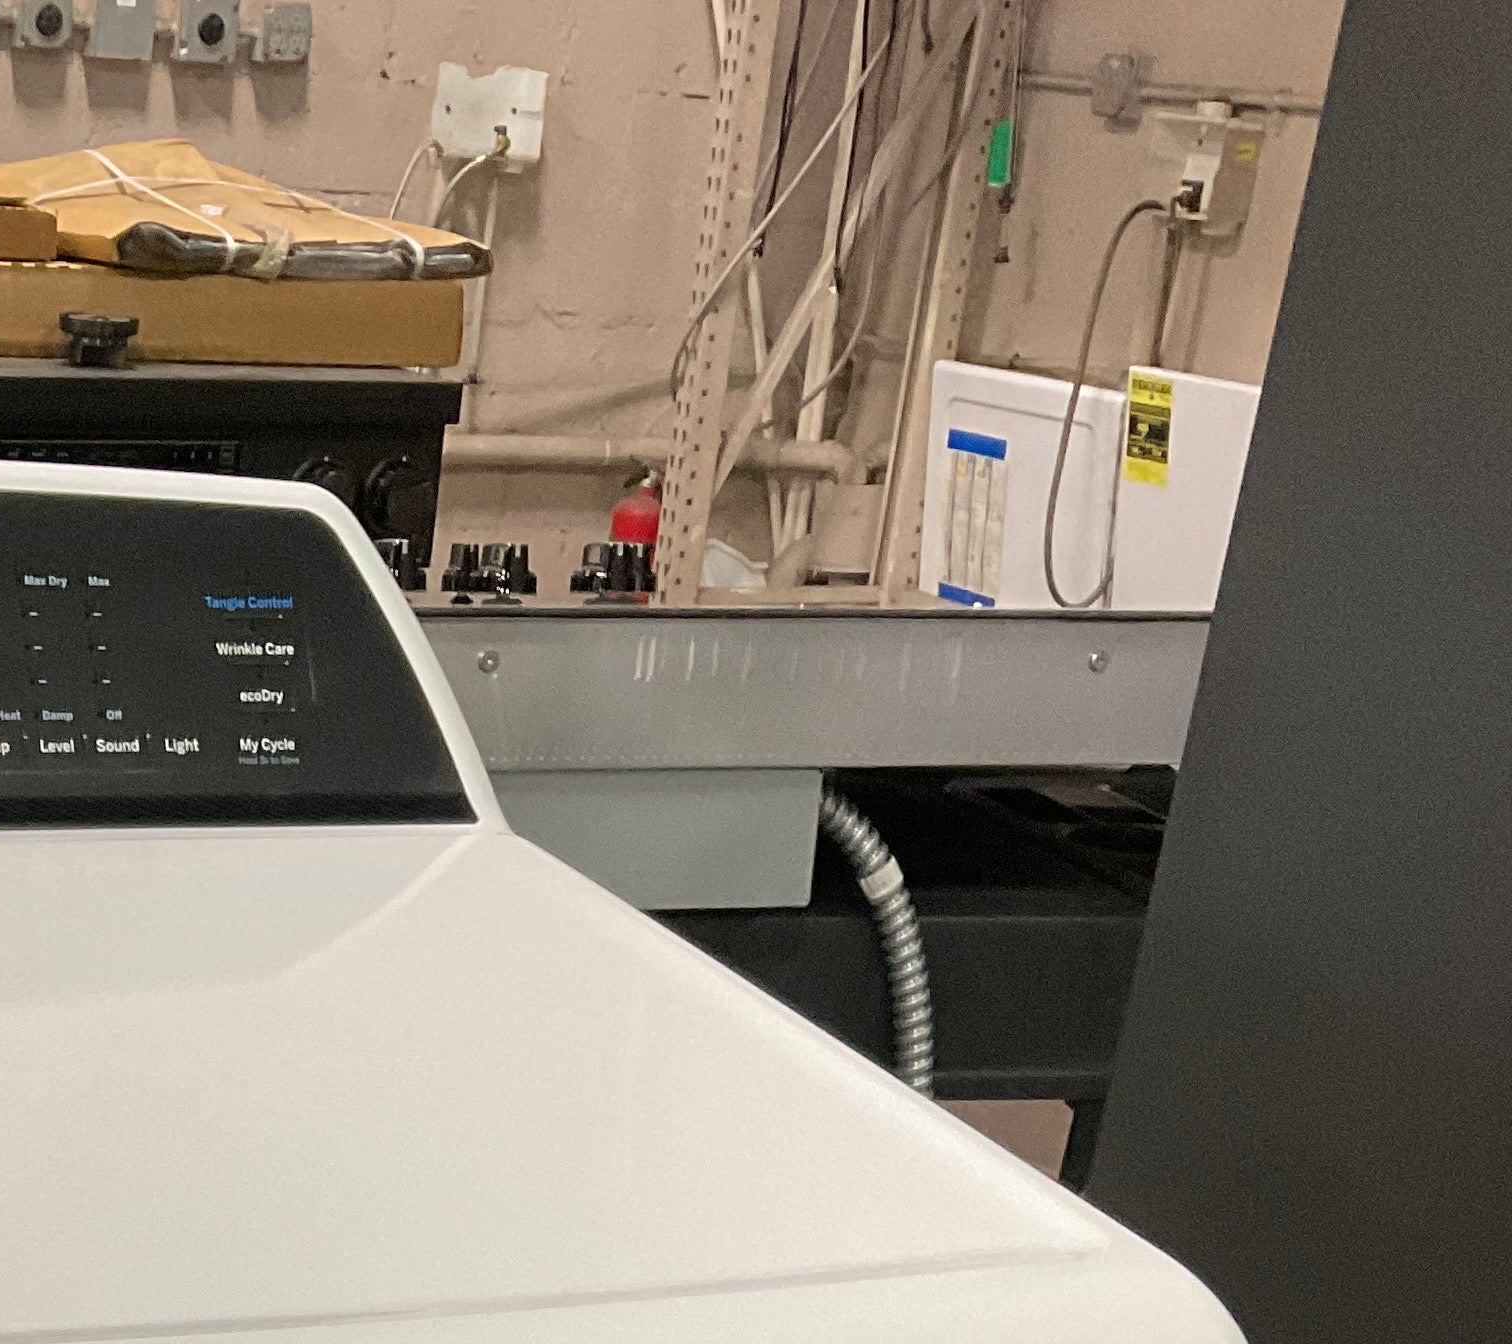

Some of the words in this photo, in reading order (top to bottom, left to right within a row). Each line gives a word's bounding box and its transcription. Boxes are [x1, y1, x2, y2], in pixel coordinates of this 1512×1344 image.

[23, 574, 46, 586] Max
[48, 575, 68, 589] Dry
[87, 575, 110, 587] Max
[204, 595, 246, 612] Tangle
[247, 596, 294, 609] Control
[215, 642, 264, 656] Wrinkle
[264, 641, 295, 656] Care
[239, 688, 284, 705] ecoDry
[42, 709, 74, 722] Damp
[39, 738, 75, 754] Level
[95, 738, 140, 753] Sound
[164, 737, 200, 755] Light
[239, 737, 259, 754] My
[260, 737, 296, 754] Cycle
